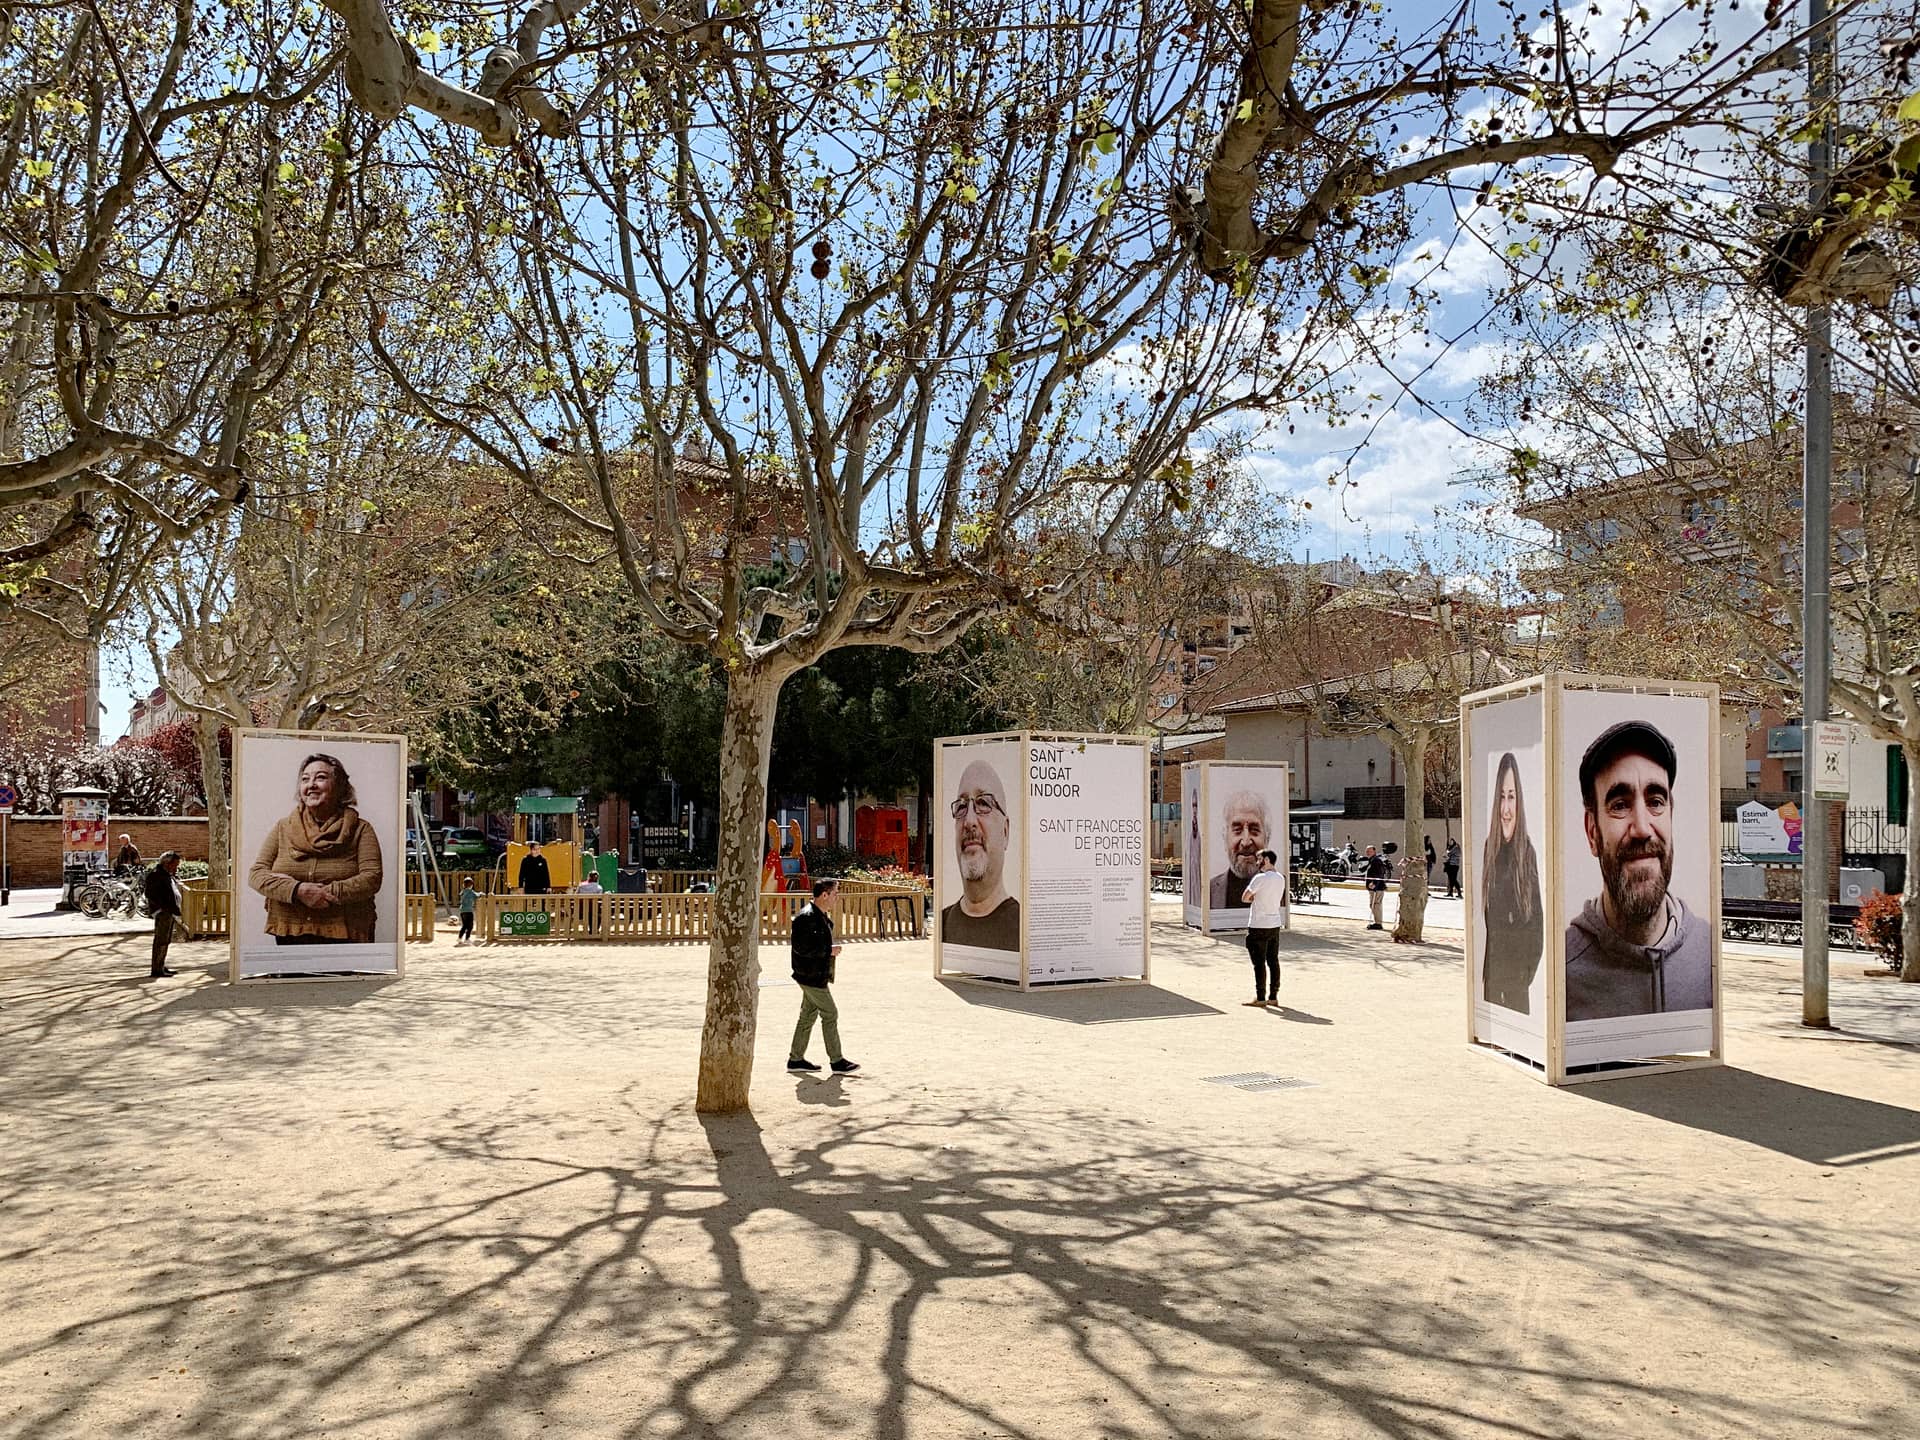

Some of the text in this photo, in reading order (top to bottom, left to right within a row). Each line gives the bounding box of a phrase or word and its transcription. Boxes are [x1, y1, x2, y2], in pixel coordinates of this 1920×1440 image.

[1030, 748, 1064, 763] SANT
[1030, 766, 1072, 780] CUGAT
[1030, 783, 1080, 798] INDOOR
[1742, 810, 1769, 818] Estimat
[1039, 818, 1142, 833] SANT FRANCESC
[1074, 836, 1142, 850] DE PORTES
[1095, 852, 1142, 867] ENDINS
